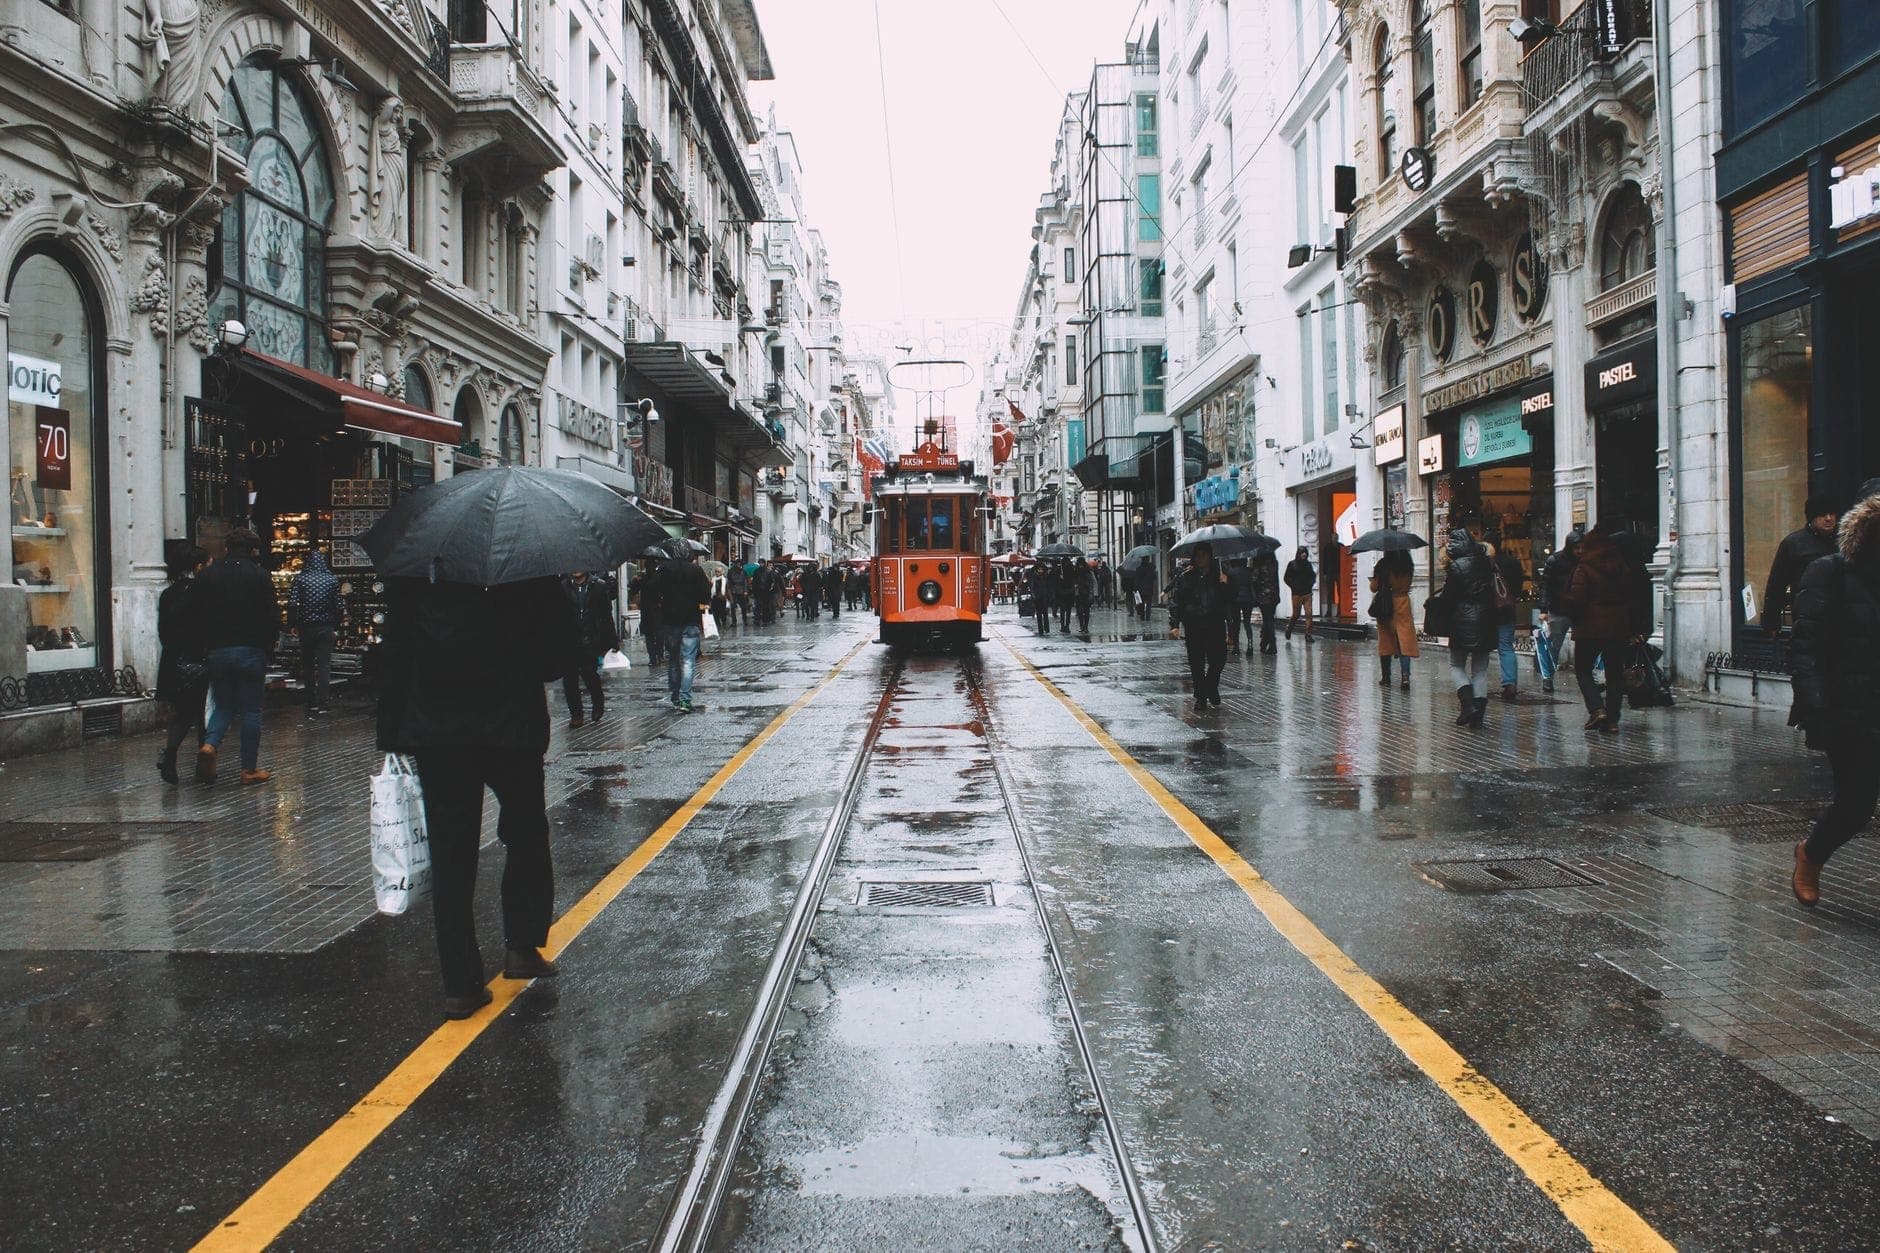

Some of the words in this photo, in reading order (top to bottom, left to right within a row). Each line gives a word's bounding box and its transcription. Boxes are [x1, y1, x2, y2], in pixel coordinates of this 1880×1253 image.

[1606, 0, 1616, 44] STAURANT
[1600, 362, 1637, 389] PASTEL
[1521, 392, 1554, 415] PASTEL
[926, 443, 931, 454] 2
[901, 456, 923, 466] TAKSİM
[937, 456, 957, 466] TÜNEL
[412, 827, 428, 845] Sh
